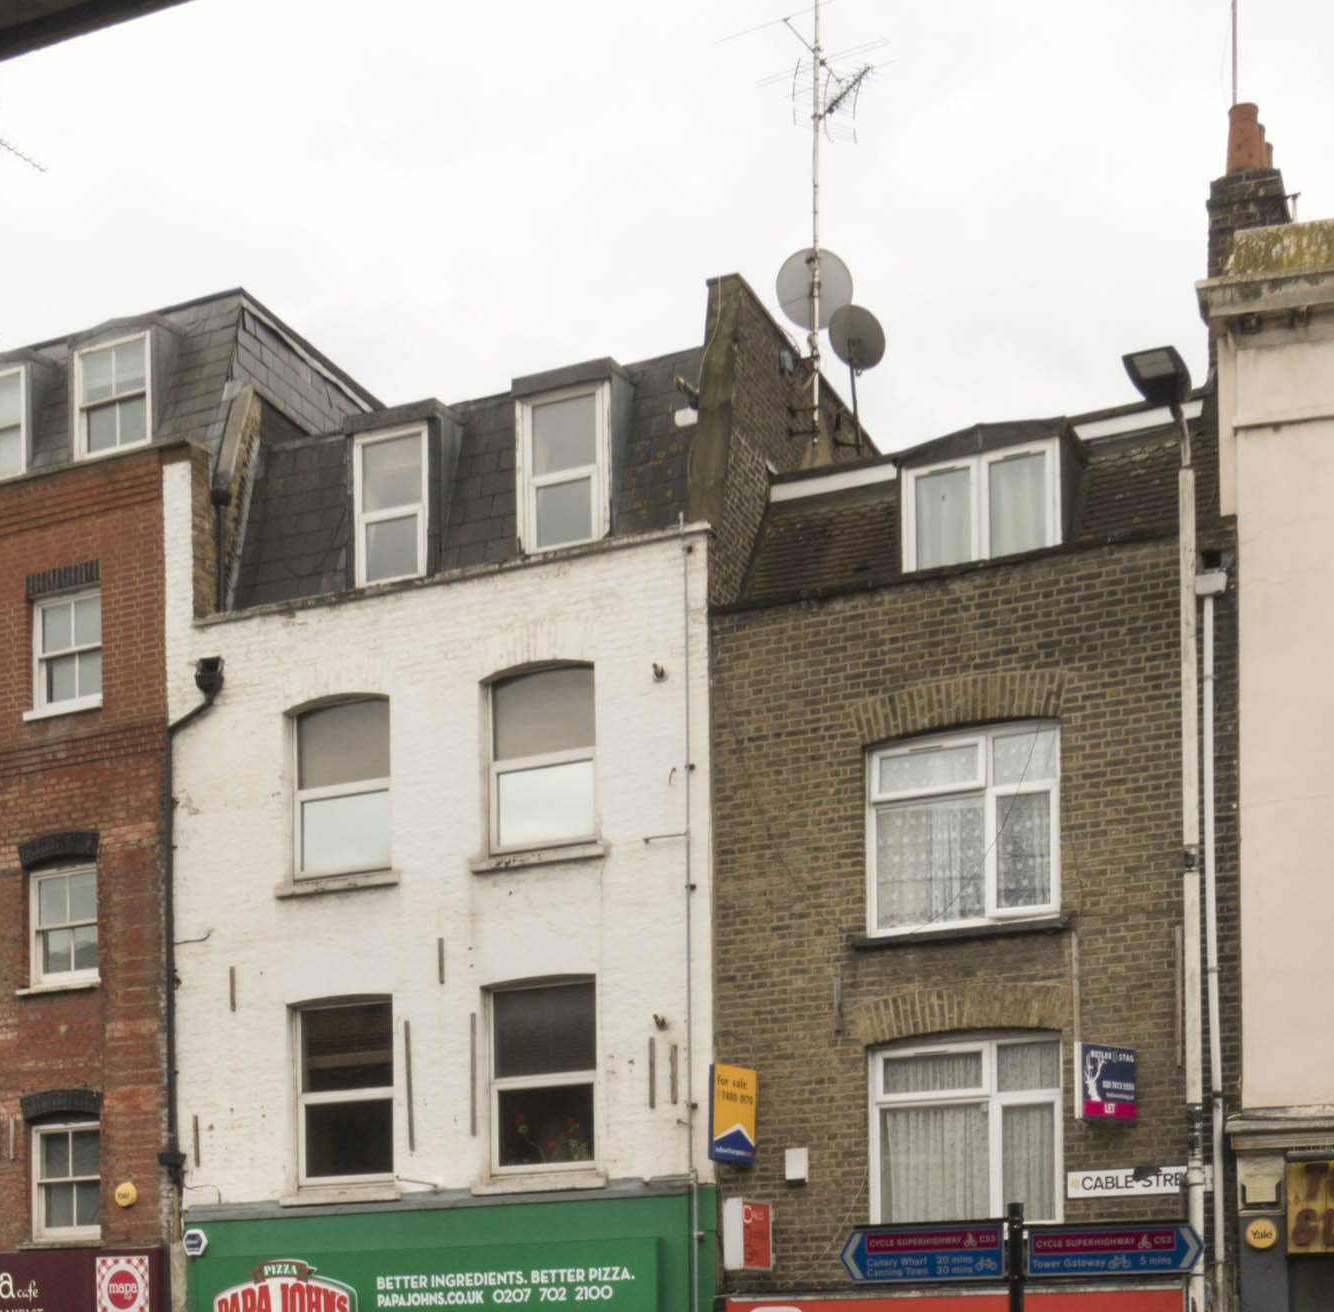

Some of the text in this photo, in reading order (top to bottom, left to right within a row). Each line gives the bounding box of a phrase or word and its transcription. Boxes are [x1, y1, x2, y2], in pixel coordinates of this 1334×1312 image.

[1119, 1053, 1135, 1063] STAG
[732, 1080, 747, 1089] sale
[1081, 1174, 1134, 1191] CABLE
[869, 1238, 894, 1248] CYCLE
[897, 1236, 962, 1247] SUPERHIGHWAY
[1251, 1229, 1273, 1241] Yale
[1035, 1239, 1062, 1249] CYCLE
[1065, 1237, 1135, 1248] SUPERHIGHWAY
[867, 1255, 973, 1268] Canary Wharf 20 mins
[1033, 1255, 1172, 1270] Tower Gateway 5 mins
[263, 1263, 298, 1277] PIZZA
[867, 1264, 973, 1278] Canning Town 30 mins
[376, 1266, 635, 1290] BETTER INGREDIENTS. BETTER PIZZA.
[17, 1279, 39, 1302] cafe
[108, 1282, 137, 1297] mapa
[377, 1285, 613, 1307] PAPAJOHNS.CO.UK 0207 702 2100
